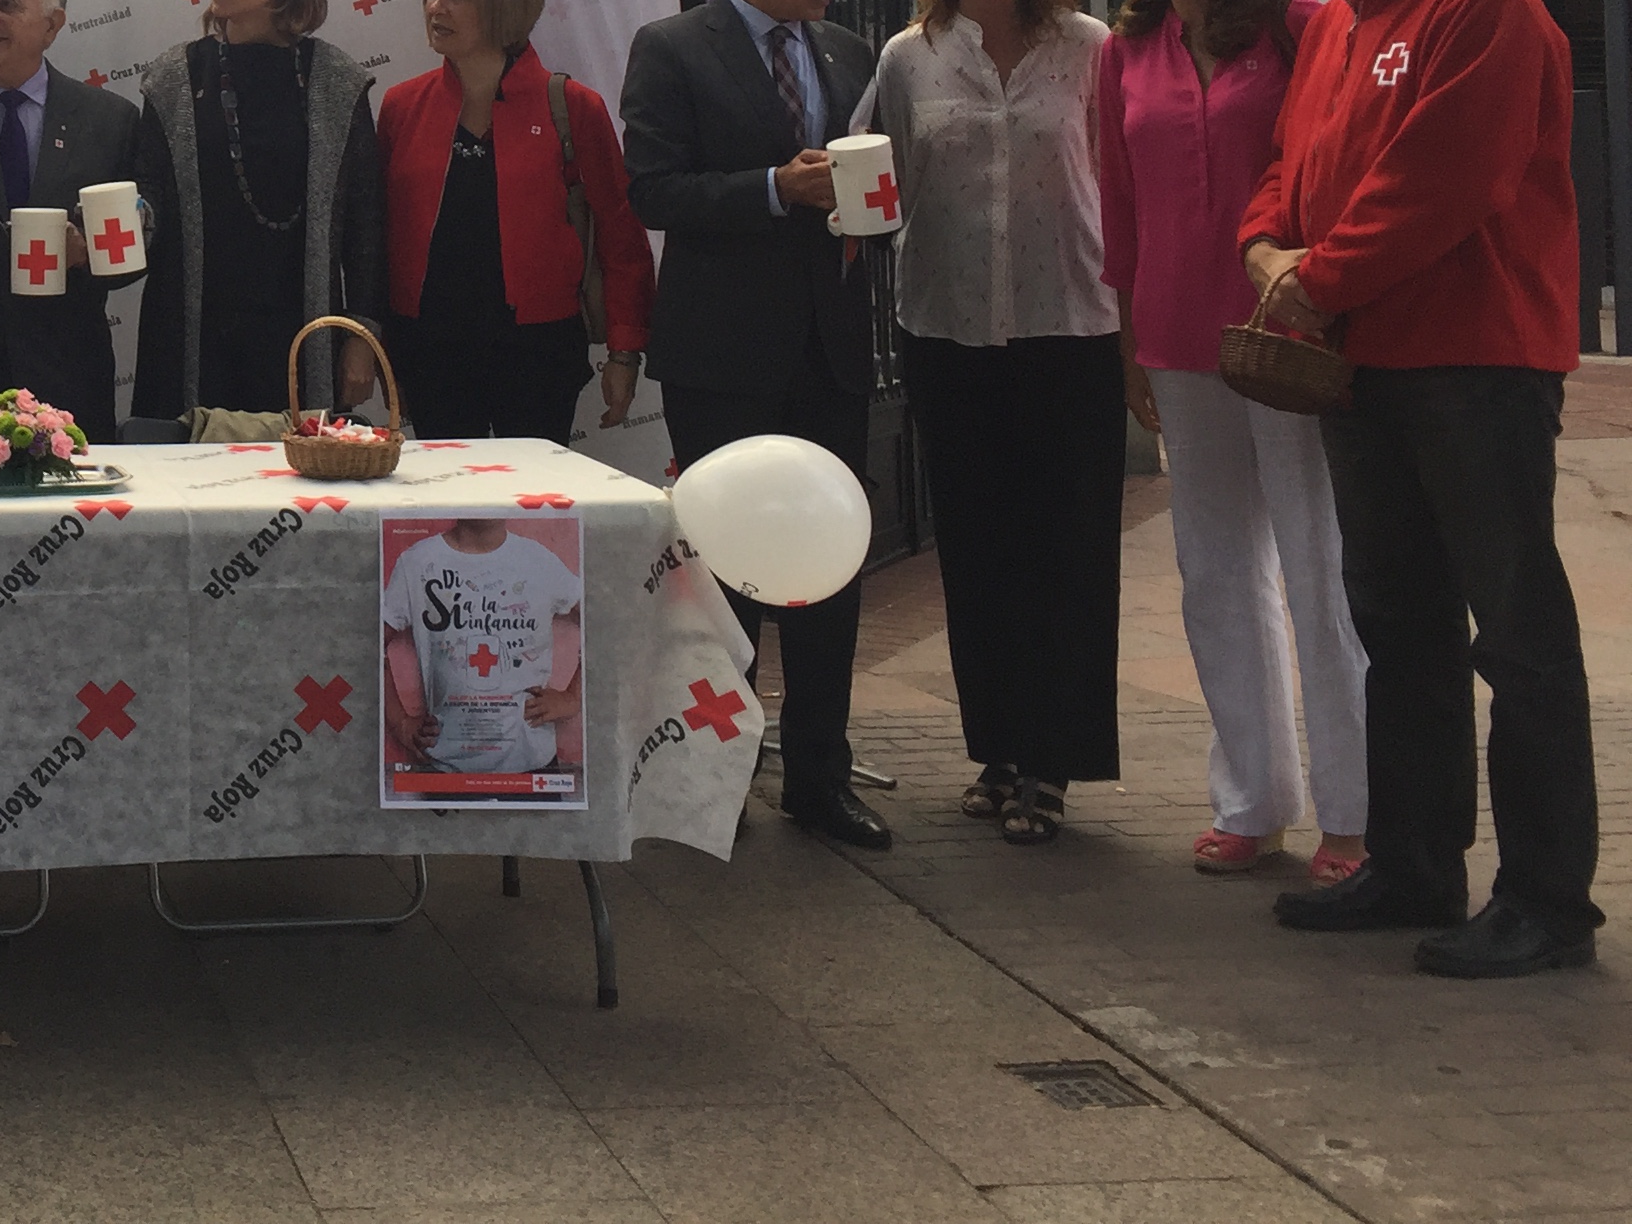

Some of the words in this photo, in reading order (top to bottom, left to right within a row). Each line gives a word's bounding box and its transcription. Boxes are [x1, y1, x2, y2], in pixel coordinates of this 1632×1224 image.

[69, 6, 132, 33] Neutralidad
[110, 67, 133, 81] Cruz
[28, 515, 85, 566] Cruz
[247, 508, 303, 557] Cruz
[202, 551, 260, 599] Roja
[442, 569, 464, 589] Di
[643, 545, 682, 594] Roja
[422, 579, 467, 632] Sí
[463, 601, 474, 614] a
[482, 596, 500, 613] la
[468, 613, 538, 636] infancia
[30, 736, 86, 787] Cruz
[248, 729, 303, 779] Cruz
[639, 718, 685, 763] Cruz
[203, 772, 260, 823] Roja
